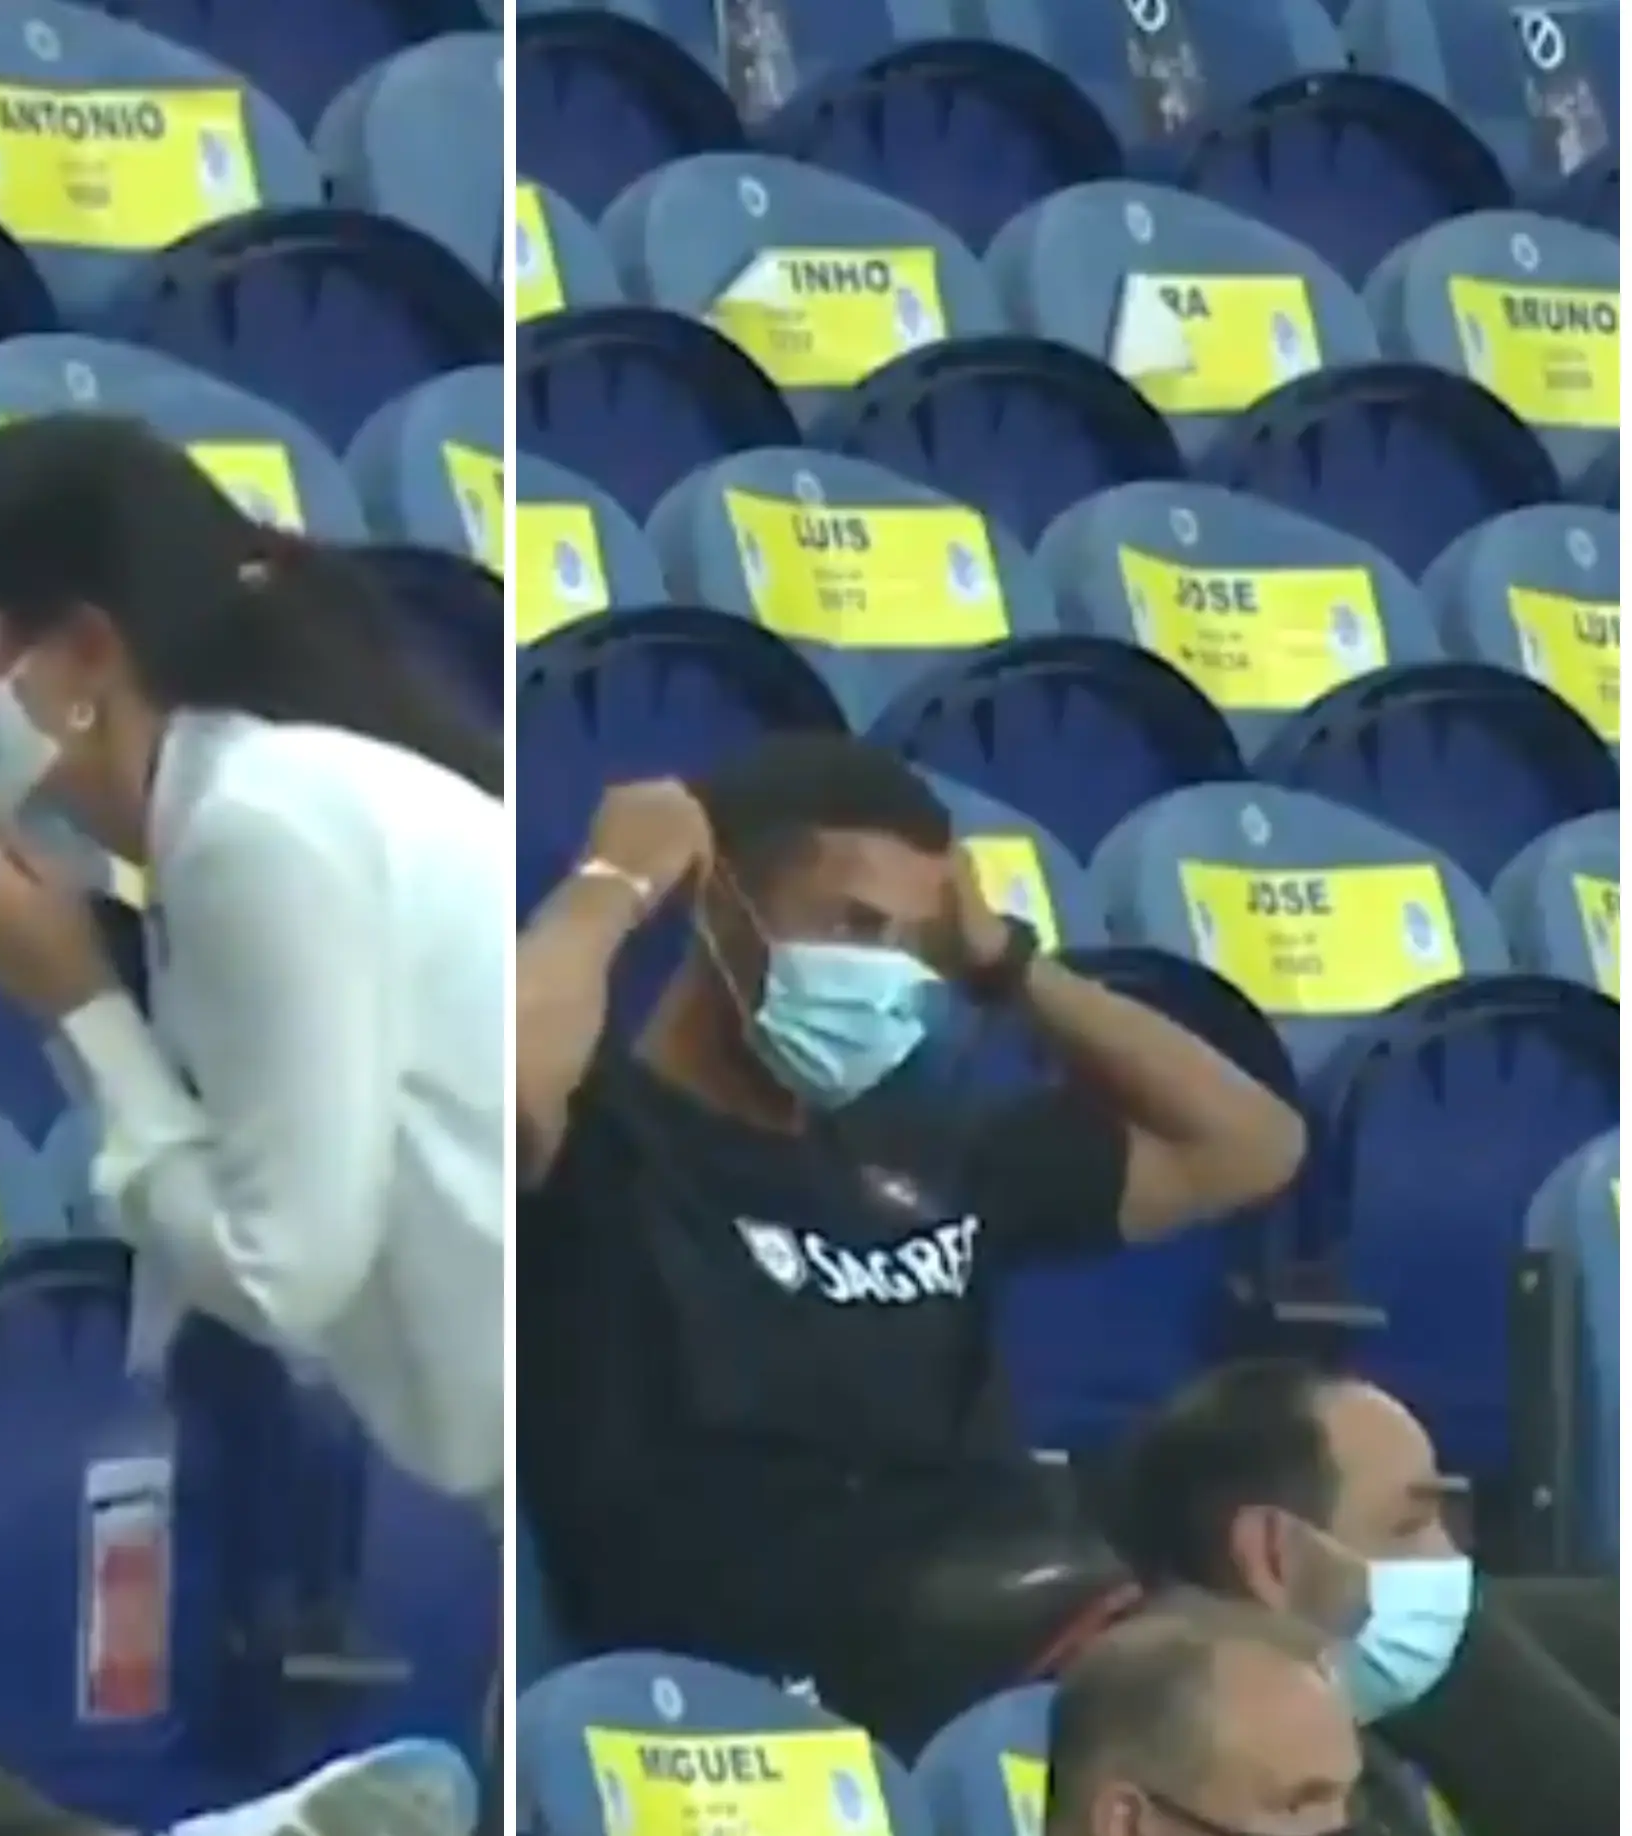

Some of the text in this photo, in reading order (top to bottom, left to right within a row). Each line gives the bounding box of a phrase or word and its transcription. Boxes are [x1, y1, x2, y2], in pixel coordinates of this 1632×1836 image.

[1501, 294, 1618, 335] BRUNO
[790, 513, 872, 555] LUIS
[1175, 576, 1260, 616] JOSE
[1247, 878, 1334, 916] JOSE
[637, 1743, 785, 1786] MIGUEL
